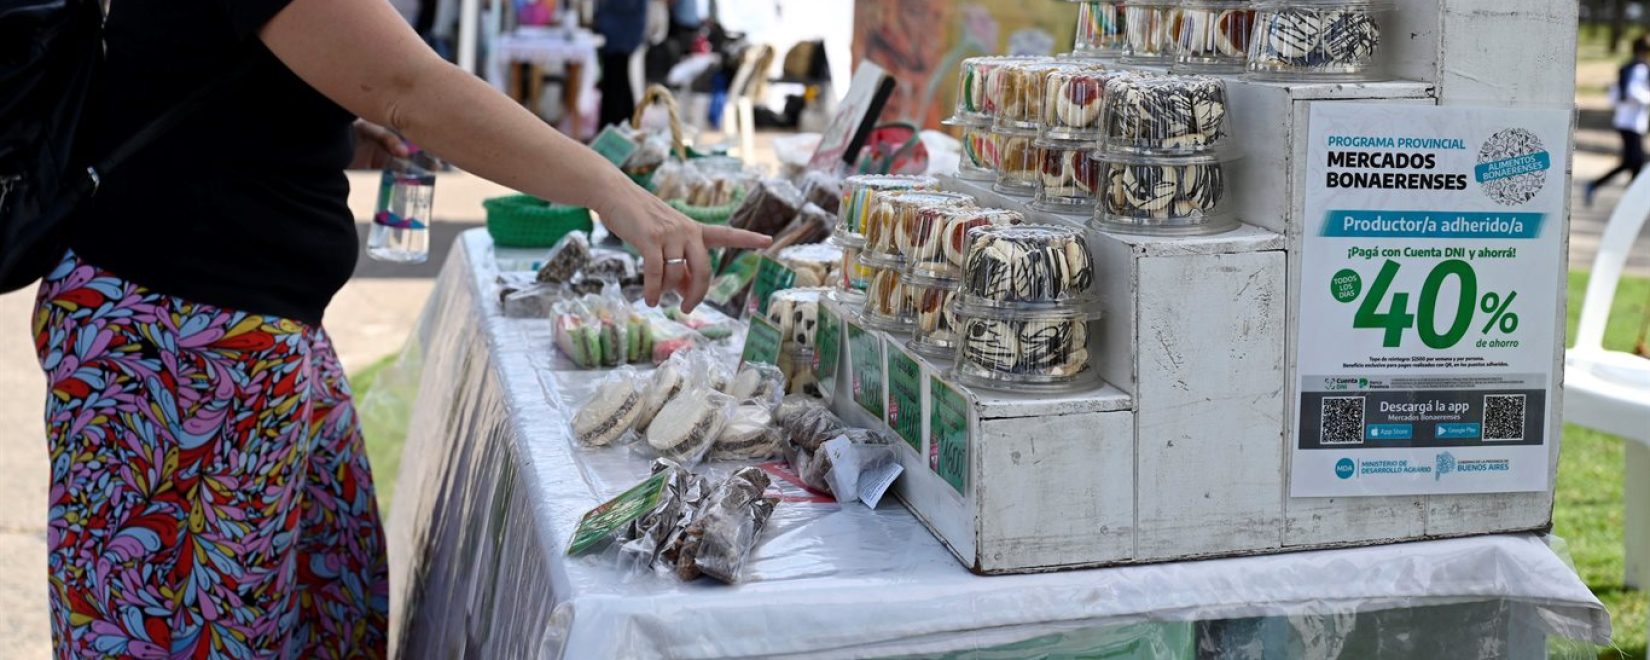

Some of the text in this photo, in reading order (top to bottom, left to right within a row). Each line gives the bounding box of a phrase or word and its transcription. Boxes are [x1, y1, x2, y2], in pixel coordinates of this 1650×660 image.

[1328, 136, 1466, 149] PROGRAMA PROVINCIAL
[1327, 151, 1436, 169] MERCADOS
[1488, 155, 1536, 171] ALIMENTOS
[1483, 161, 1543, 180] BONAERENSES
[1326, 172, 1467, 190] BONAERENSES
[1343, 215, 1523, 235] Productor/a adherido/a
[1348, 246, 1516, 260] ¡Pagá con Cuenta DNI y ahorrá!
[1333, 275, 1358, 285] TODOS
[1339, 283, 1353, 291] LOS
[1353, 259, 1477, 349] 40
[1476, 339, 1519, 348] de ahorro
[1380, 400, 1470, 414] Descargá la app
[1380, 428, 1394, 436] App
